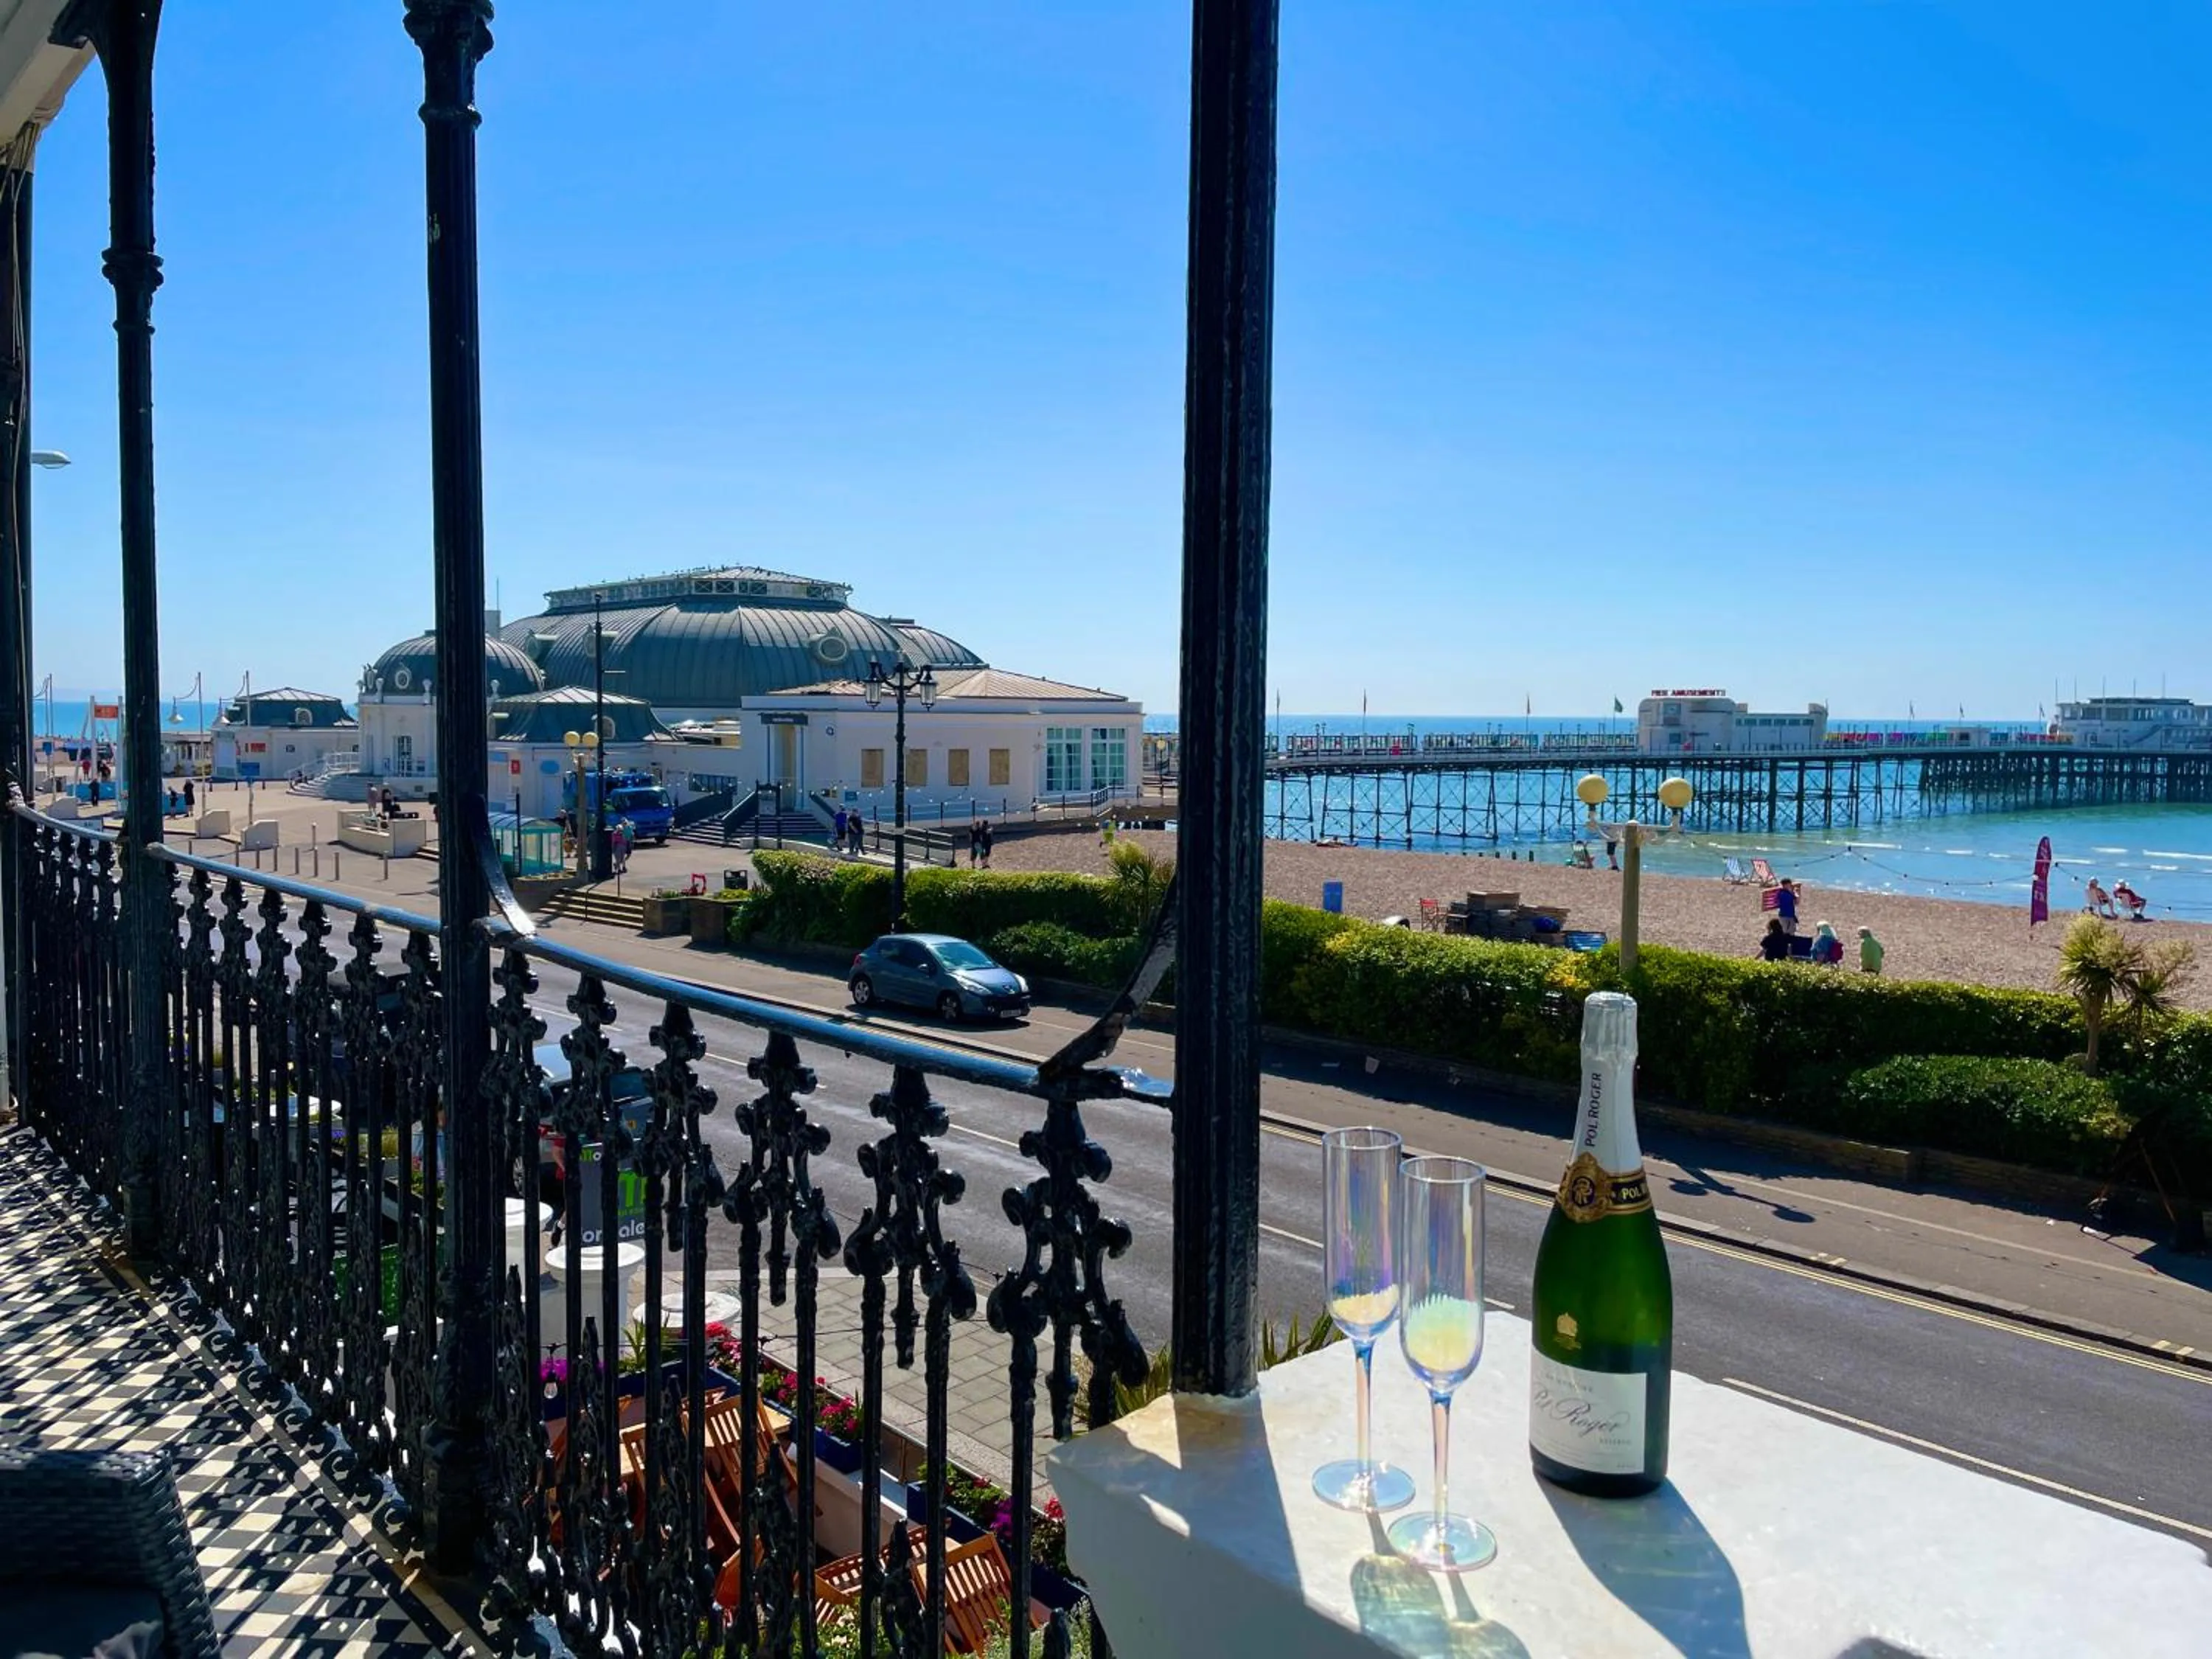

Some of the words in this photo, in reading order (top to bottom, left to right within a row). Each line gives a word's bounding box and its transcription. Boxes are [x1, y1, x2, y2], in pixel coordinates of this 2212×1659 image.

[1587, 1072, 1602, 1119] ROGER
[1585, 1121, 1599, 1147] POL
[1621, 1186, 1641, 1200] POL
[1550, 1397, 1631, 1438] Roger
